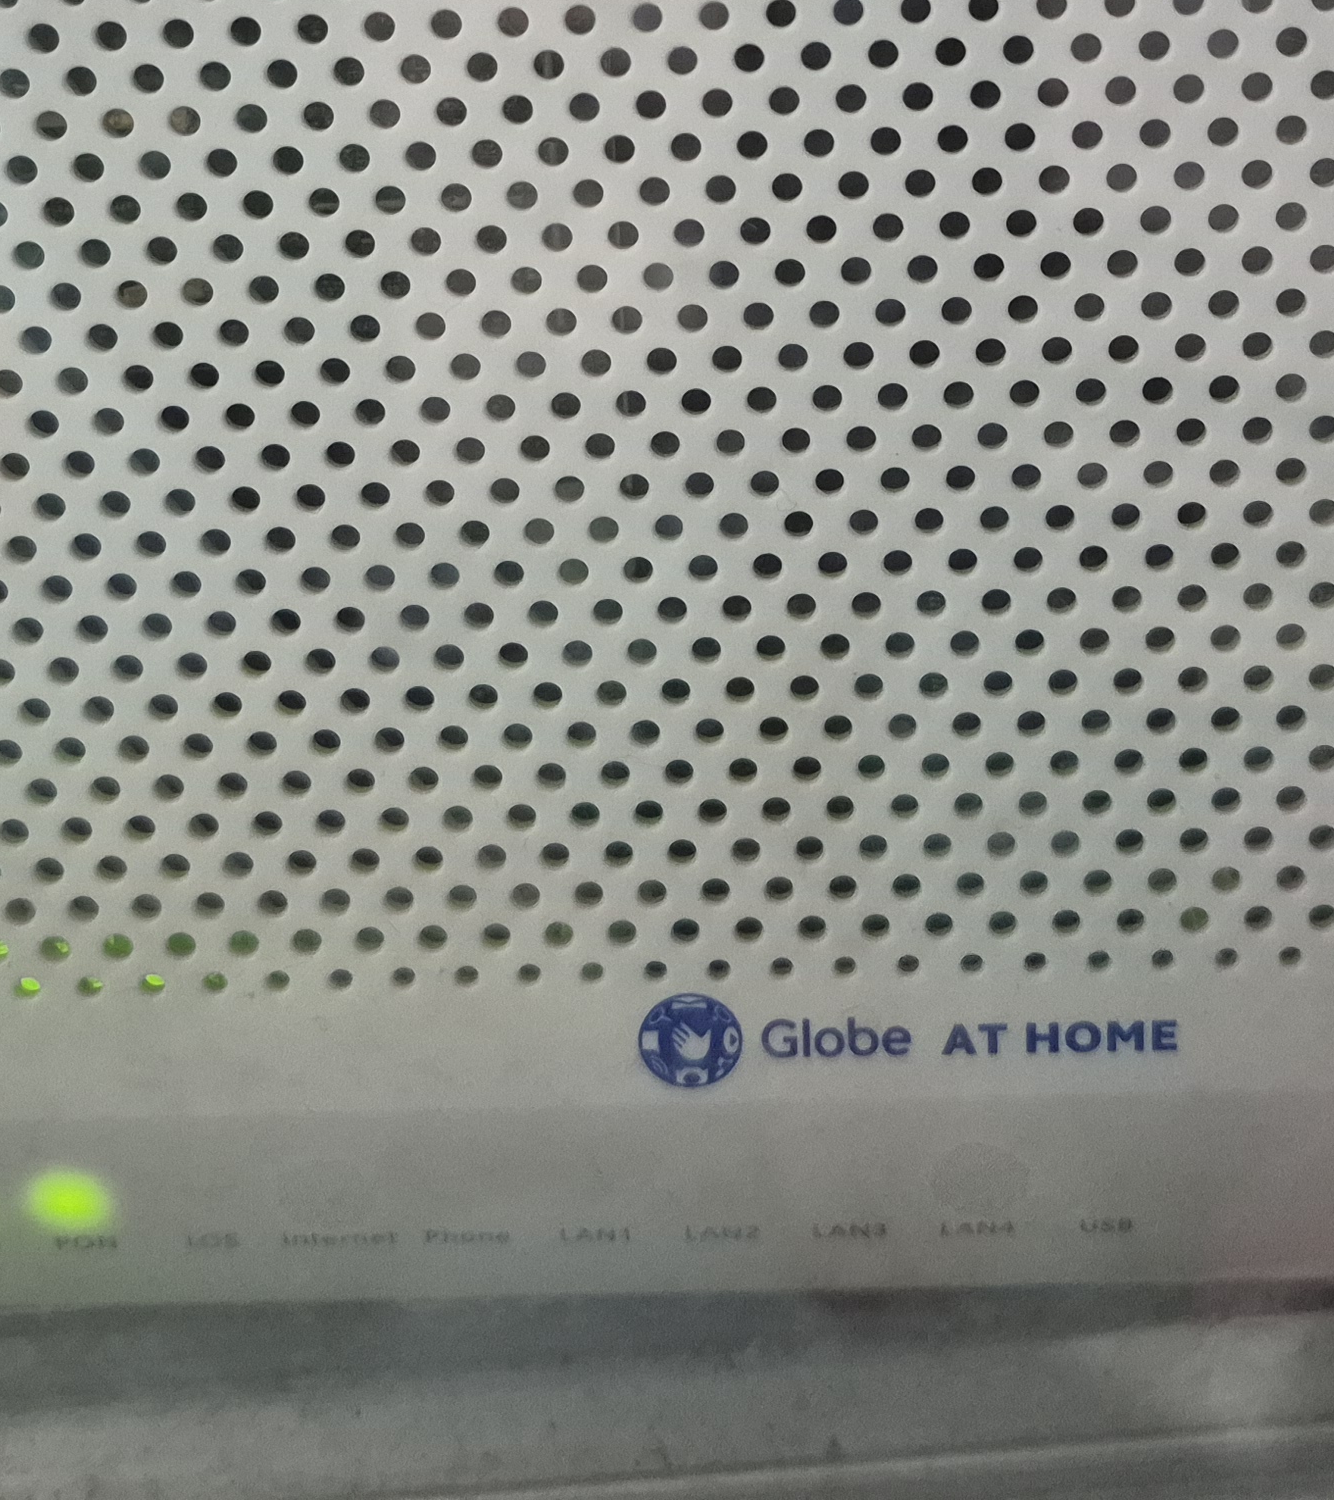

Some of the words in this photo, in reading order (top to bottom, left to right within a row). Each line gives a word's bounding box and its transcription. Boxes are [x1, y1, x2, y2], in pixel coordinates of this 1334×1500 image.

[761, 1016, 912, 1059] Globe
[941, 1021, 1008, 1056] AT
[1024, 1018, 1178, 1055] HOME
[281, 1228, 398, 1248] Internet
[423, 1227, 512, 1246] Phone
[560, 1225, 633, 1243] LAN1
